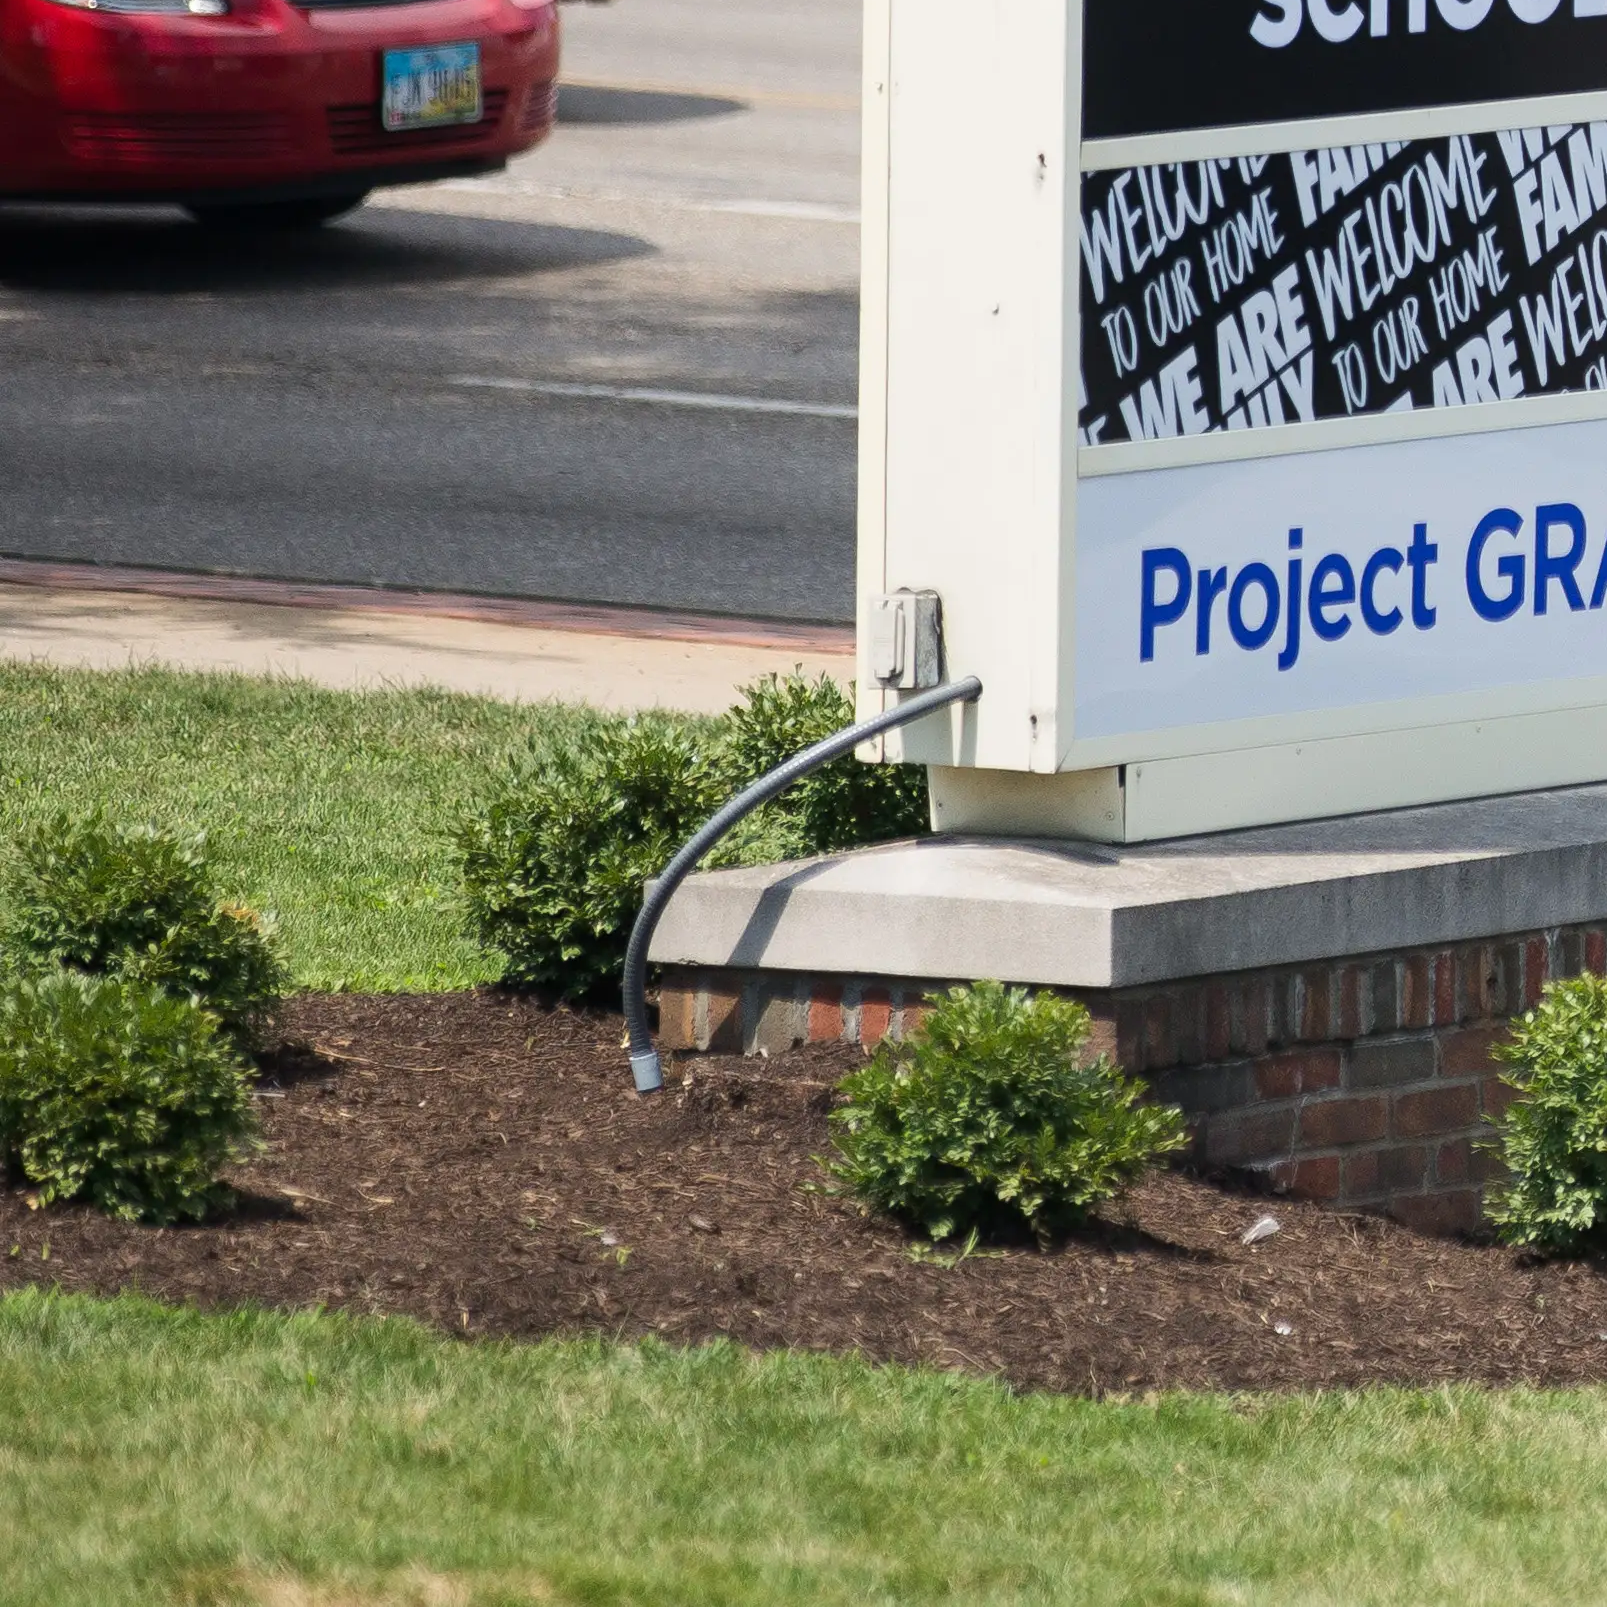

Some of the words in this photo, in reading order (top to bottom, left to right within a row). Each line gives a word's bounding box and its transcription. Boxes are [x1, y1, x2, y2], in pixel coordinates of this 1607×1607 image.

[1101, 306, 1138, 378] TO
[1144, 257, 1202, 347] OUR
[1201, 186, 1285, 304] HOME
[1305, 135, 1498, 342] WELCOME
[1332, 342, 1368, 415] TO
[1373, 297, 1430, 385] OUR
[1429, 225, 1511, 340] HOME
[1120, 345, 1210, 441] WE
[1216, 262, 1313, 415] ARE
[1139, 521, 1438, 672] Project
